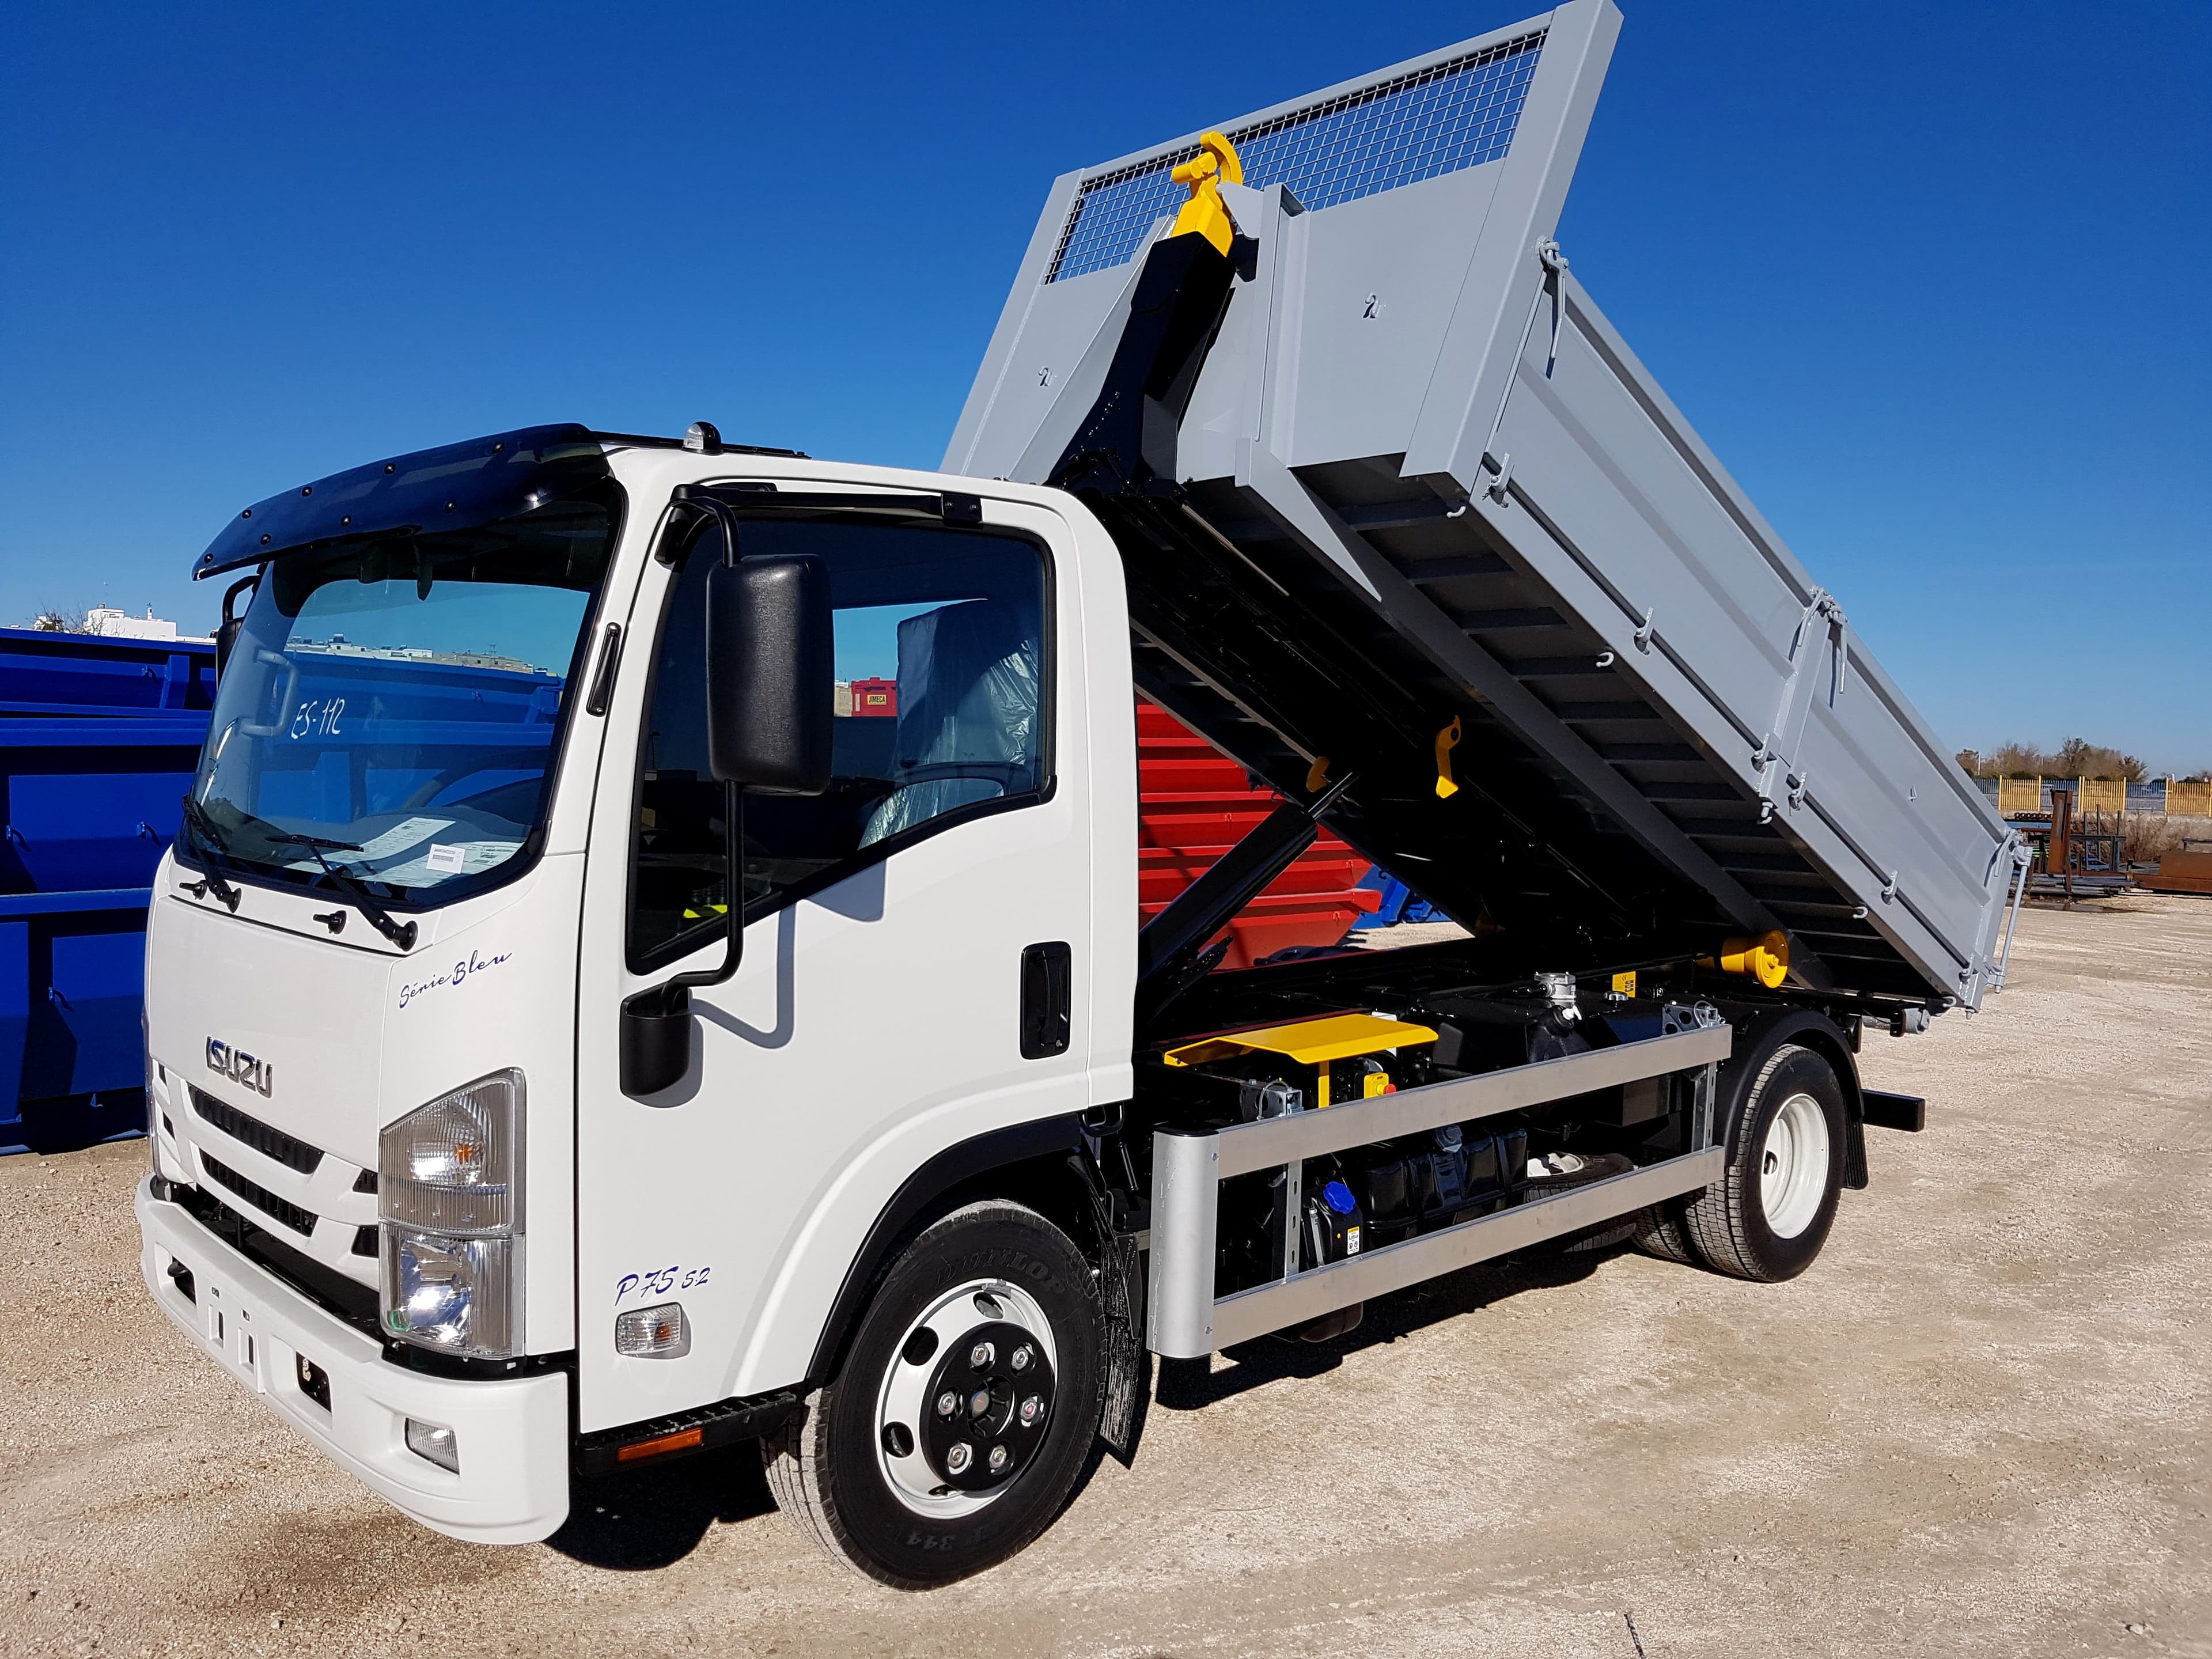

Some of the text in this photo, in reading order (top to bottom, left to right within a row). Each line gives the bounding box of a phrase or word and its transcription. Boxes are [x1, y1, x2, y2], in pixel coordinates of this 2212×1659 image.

[291, 697, 345, 740] ES-112
[452, 949, 512, 986] Bleu
[206, 1036, 272, 1099] ISUZU
